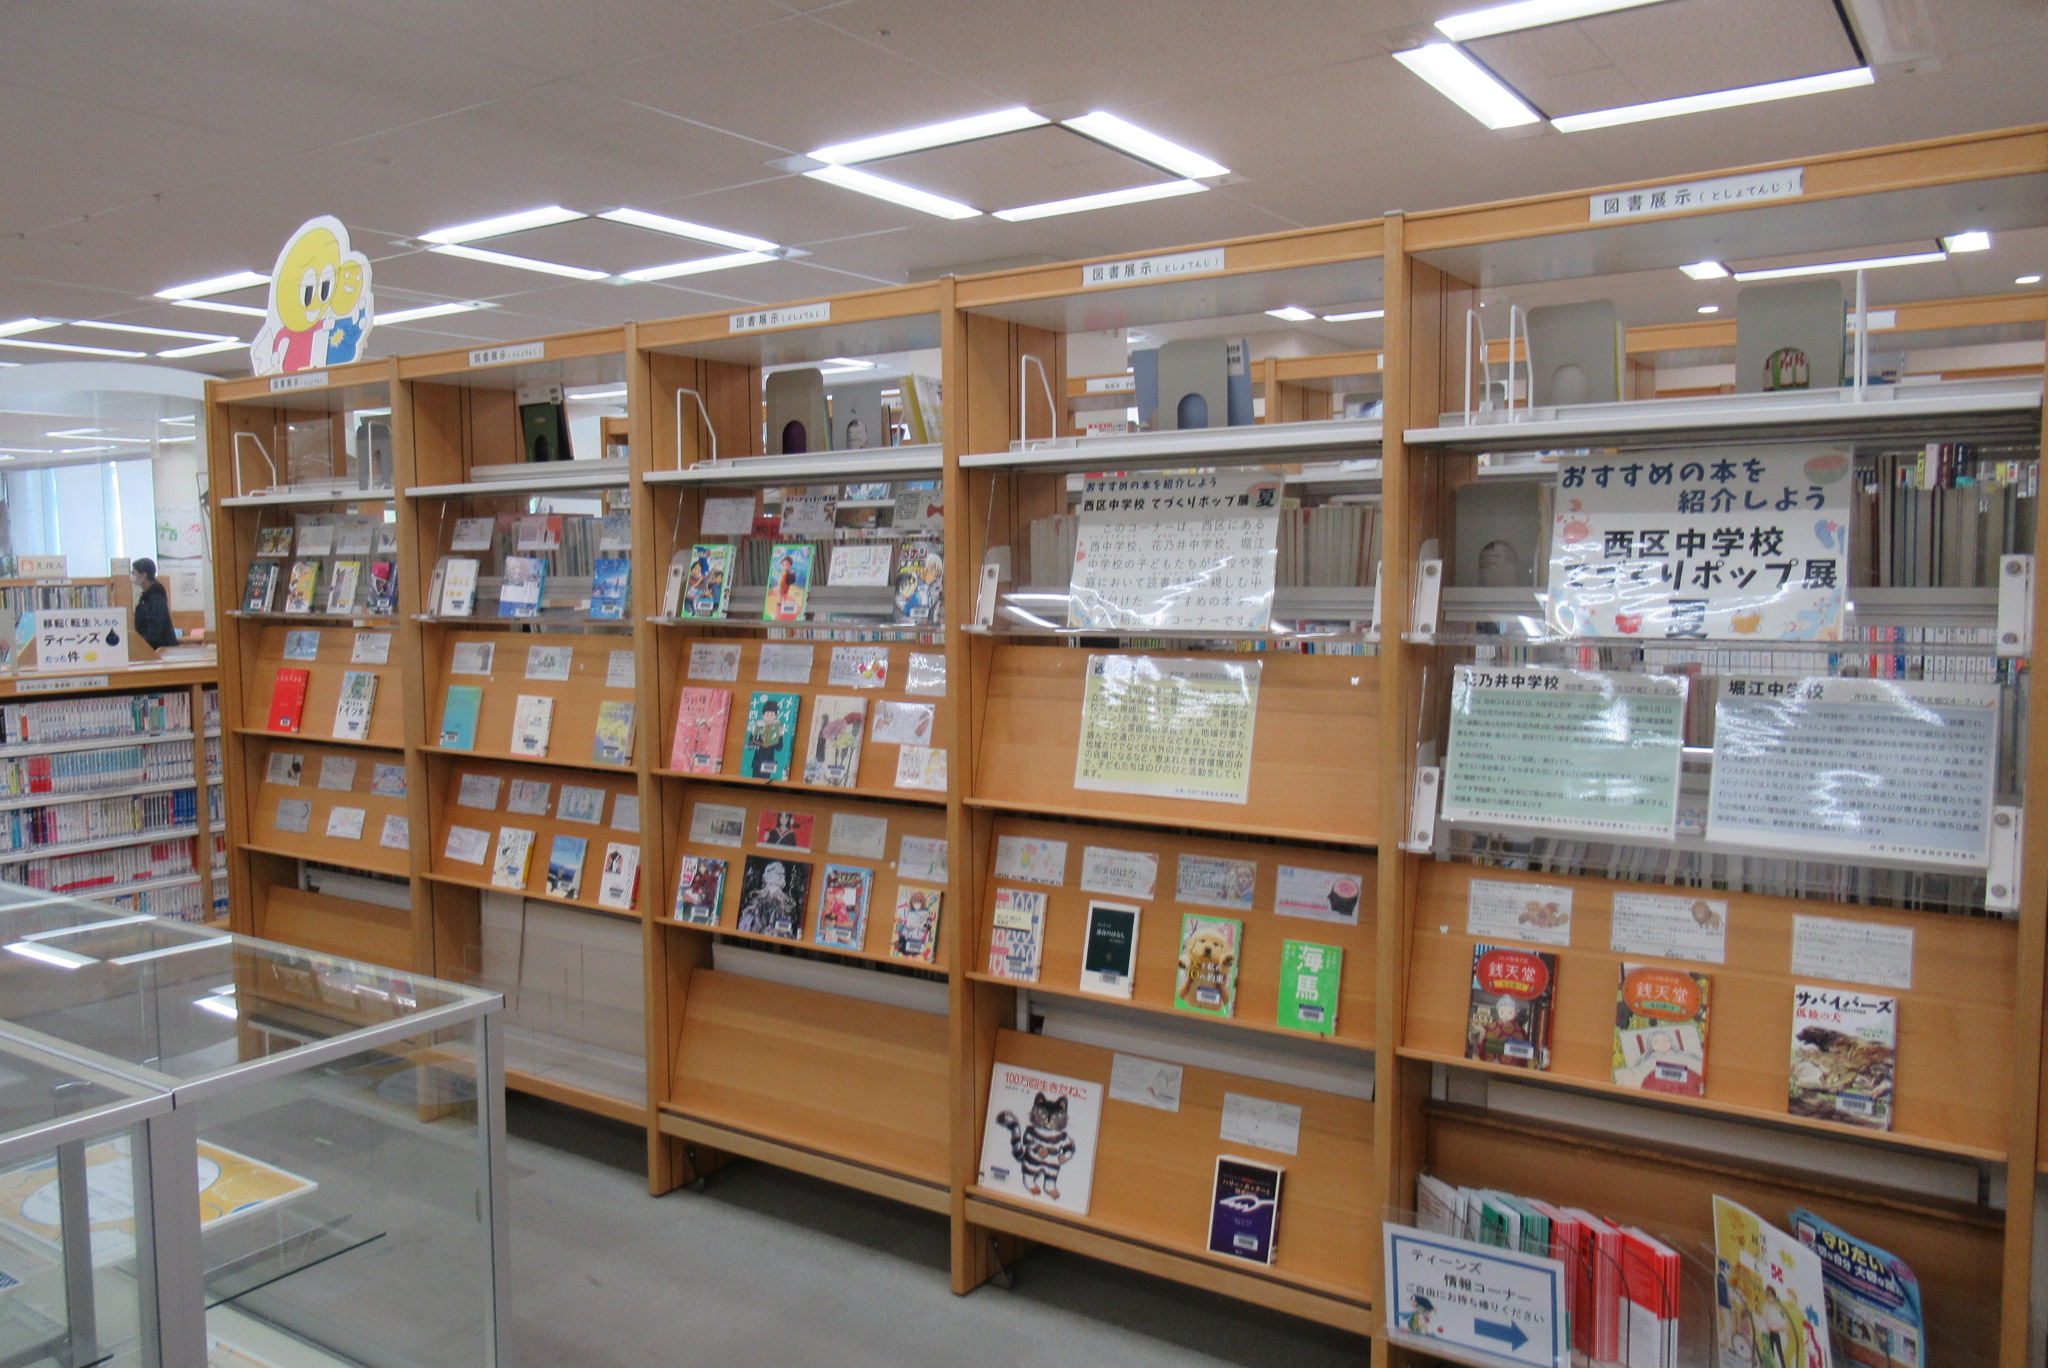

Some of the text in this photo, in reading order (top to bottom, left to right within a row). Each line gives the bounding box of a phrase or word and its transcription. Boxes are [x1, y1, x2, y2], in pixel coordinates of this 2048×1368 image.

[1086, 477, 1217, 492] おすすめの本を紹介しよう
[1562, 458, 1766, 488] おすすめの本を
[1083, 498, 1145, 512] 西区中学校
[1256, 487, 1276, 507] 夏
[1677, 486, 1827, 514] 紹介しよう
[1603, 526, 1784, 559] 西区中学校
[1665, 599, 1710, 639] 夏
[1463, 673, 1559, 690] 花乃井中学校
[1728, 680, 1825, 700] 堀江中学校
[1296, 945, 1324, 1001] 海馬
[1488, 961, 1536, 983] 銭天堂
[1636, 982, 1688, 1004] 銭天堂
[1796, 991, 1894, 1014] サバイバーズ
[1796, 1007, 1841, 1023] 孤独の犬
[1005, 1072, 1087, 1100] 100万回生きたねこ
[1411, 1249, 1482, 1275] ティーンズ
[1822, 1230, 1885, 1274] 守りたい
[1444, 1273, 1532, 1302] 情報コーナー
[1406, 1283, 1545, 1323] ご自由にお持ち帰りください
